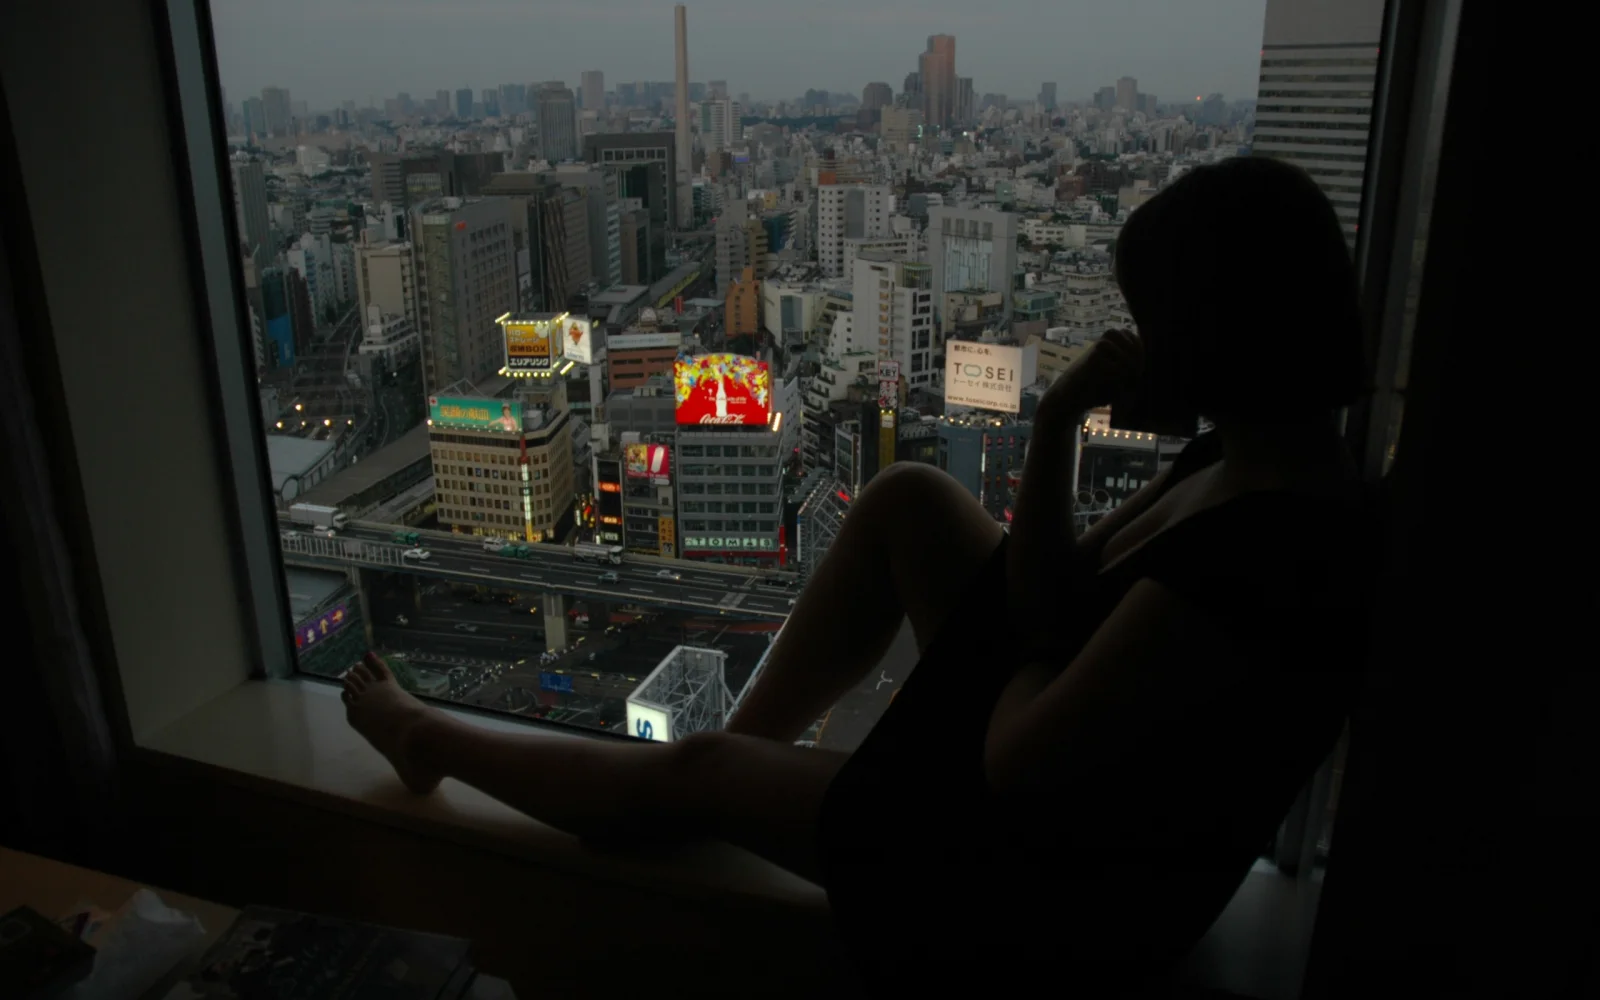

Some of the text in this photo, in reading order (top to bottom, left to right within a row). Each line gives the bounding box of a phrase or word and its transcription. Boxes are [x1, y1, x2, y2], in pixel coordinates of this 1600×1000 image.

[509, 357, 549, 367] エリアリング
[953, 362, 1014, 382] TOSEI
